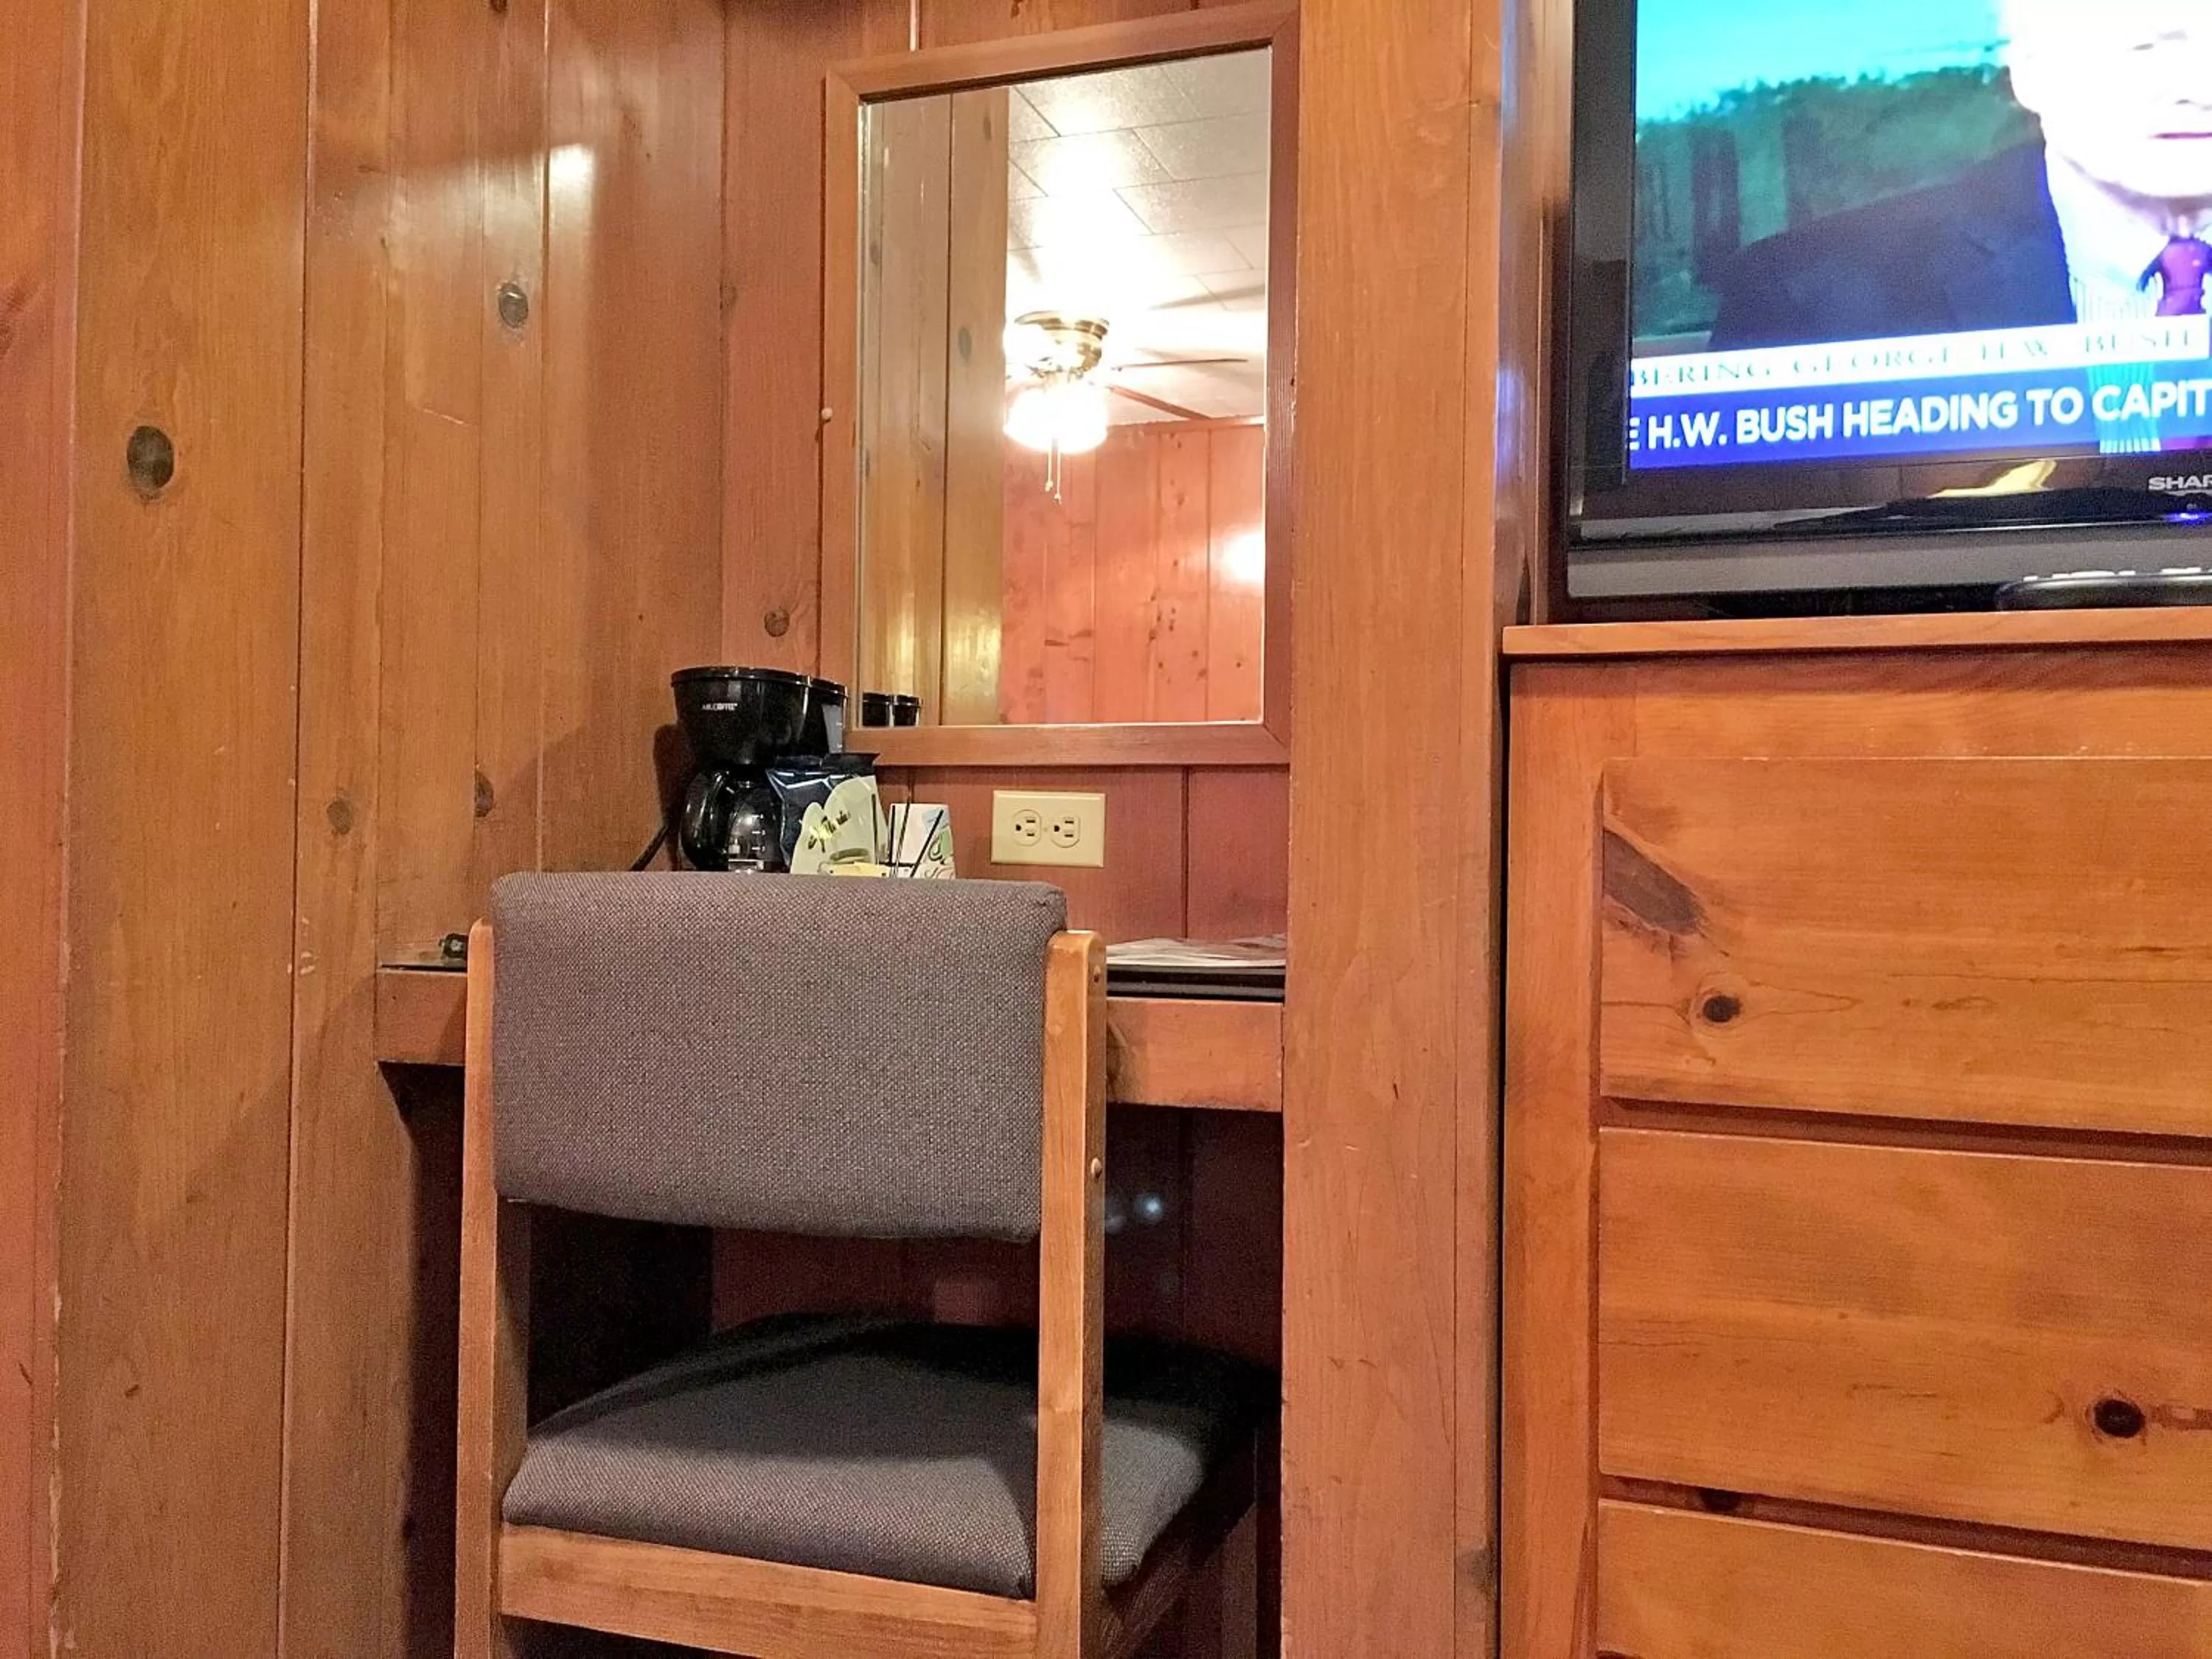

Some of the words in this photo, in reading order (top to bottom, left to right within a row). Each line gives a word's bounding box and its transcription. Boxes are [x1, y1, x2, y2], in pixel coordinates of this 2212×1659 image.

[1648, 411, 1728, 449] H.W.
[1736, 403, 1834, 444] BUSH
[1843, 391, 2019, 437] HEADING
[2025, 386, 2084, 426] TO
[2092, 379, 2212, 421] CAPIT
